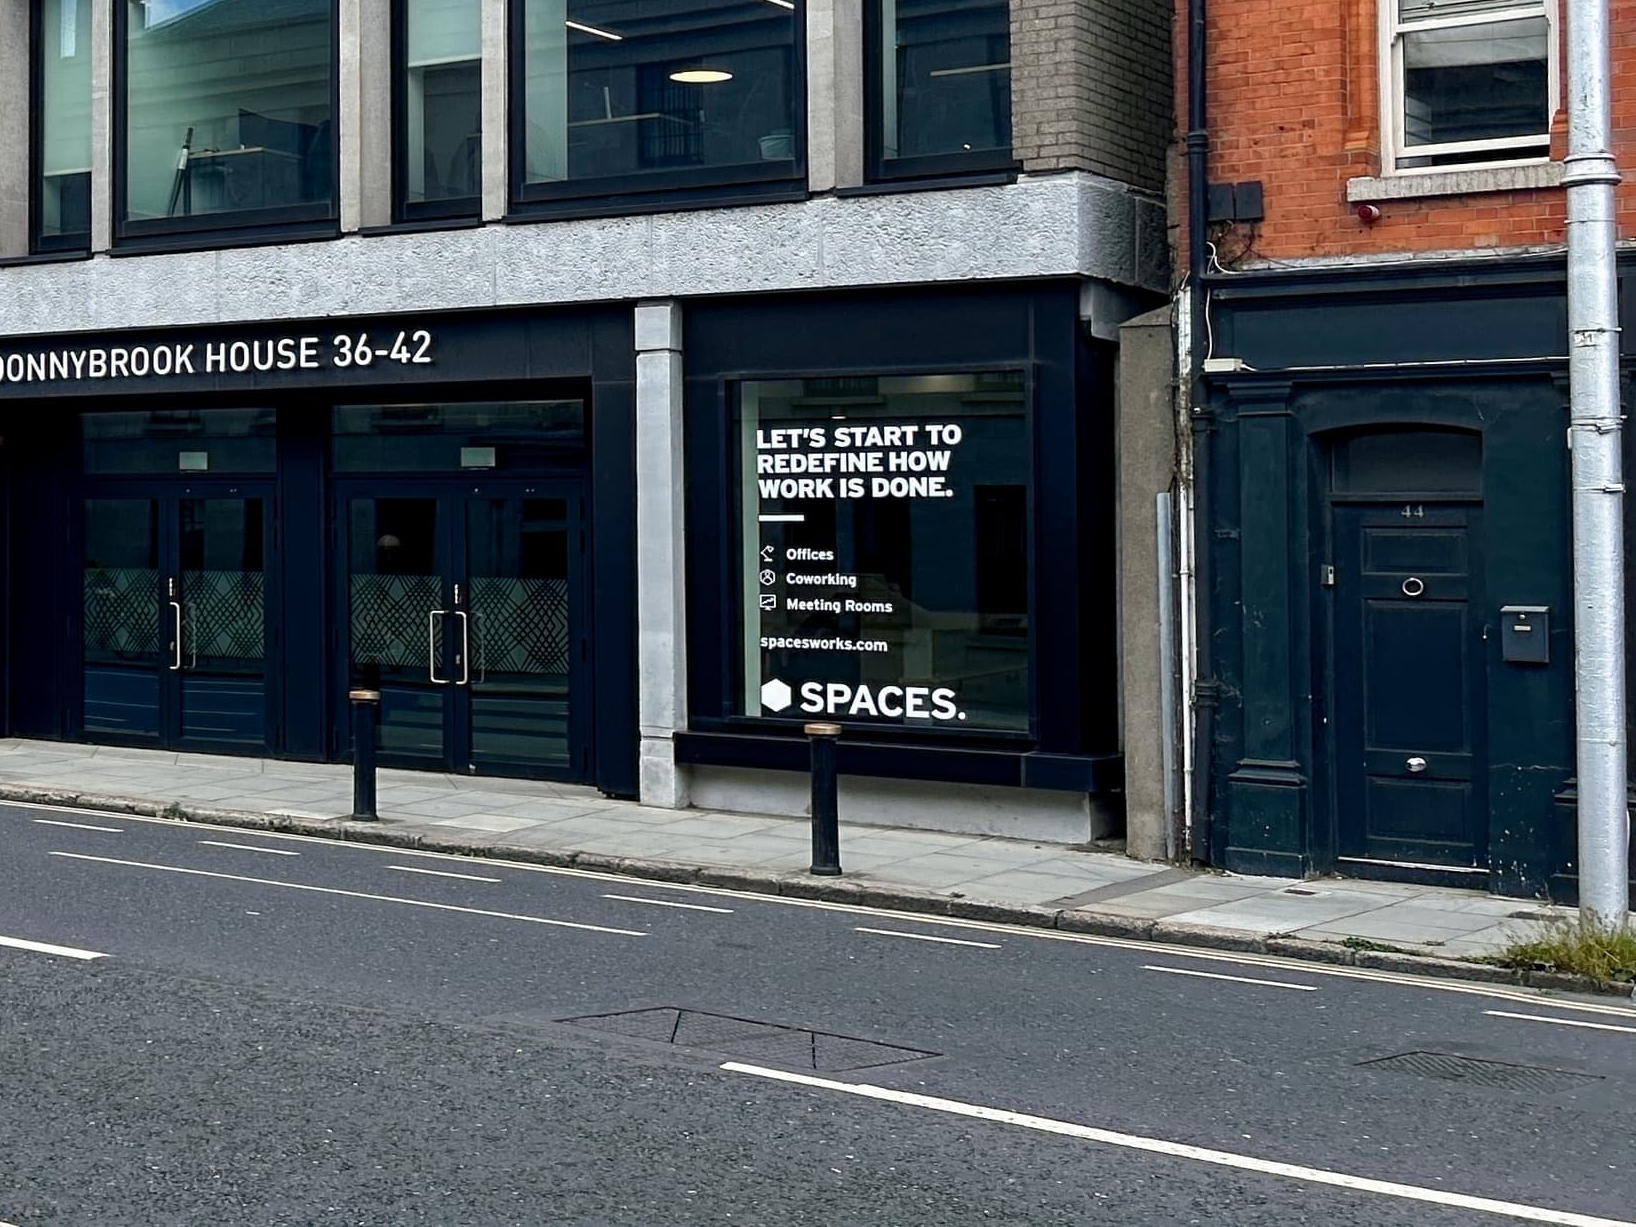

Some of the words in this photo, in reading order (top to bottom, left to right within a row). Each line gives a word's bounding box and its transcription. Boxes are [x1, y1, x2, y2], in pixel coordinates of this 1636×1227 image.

[205, 337, 319, 373] HOUSE
[332, 330, 432, 366] 36-42
[756, 427, 826, 449] LET'S
[834, 425, 918, 447] START
[925, 424, 962, 445] TO
[757, 451, 884, 474] REDEFINE
[888, 450, 951, 472] HOW
[757, 478, 836, 498] WORK
[839, 477, 865, 498] IS
[871, 476, 954, 498] DONE.
[1401, 504, 1424, 518] 44
[786, 548, 834, 561] Offices
[786, 572, 857, 588] Coworking
[786, 598, 841, 614] Meeting
[845, 600, 893, 613] Rooms
[760, 635, 888, 652] spacesworks.com
[800, 682, 966, 720] SPACES.
